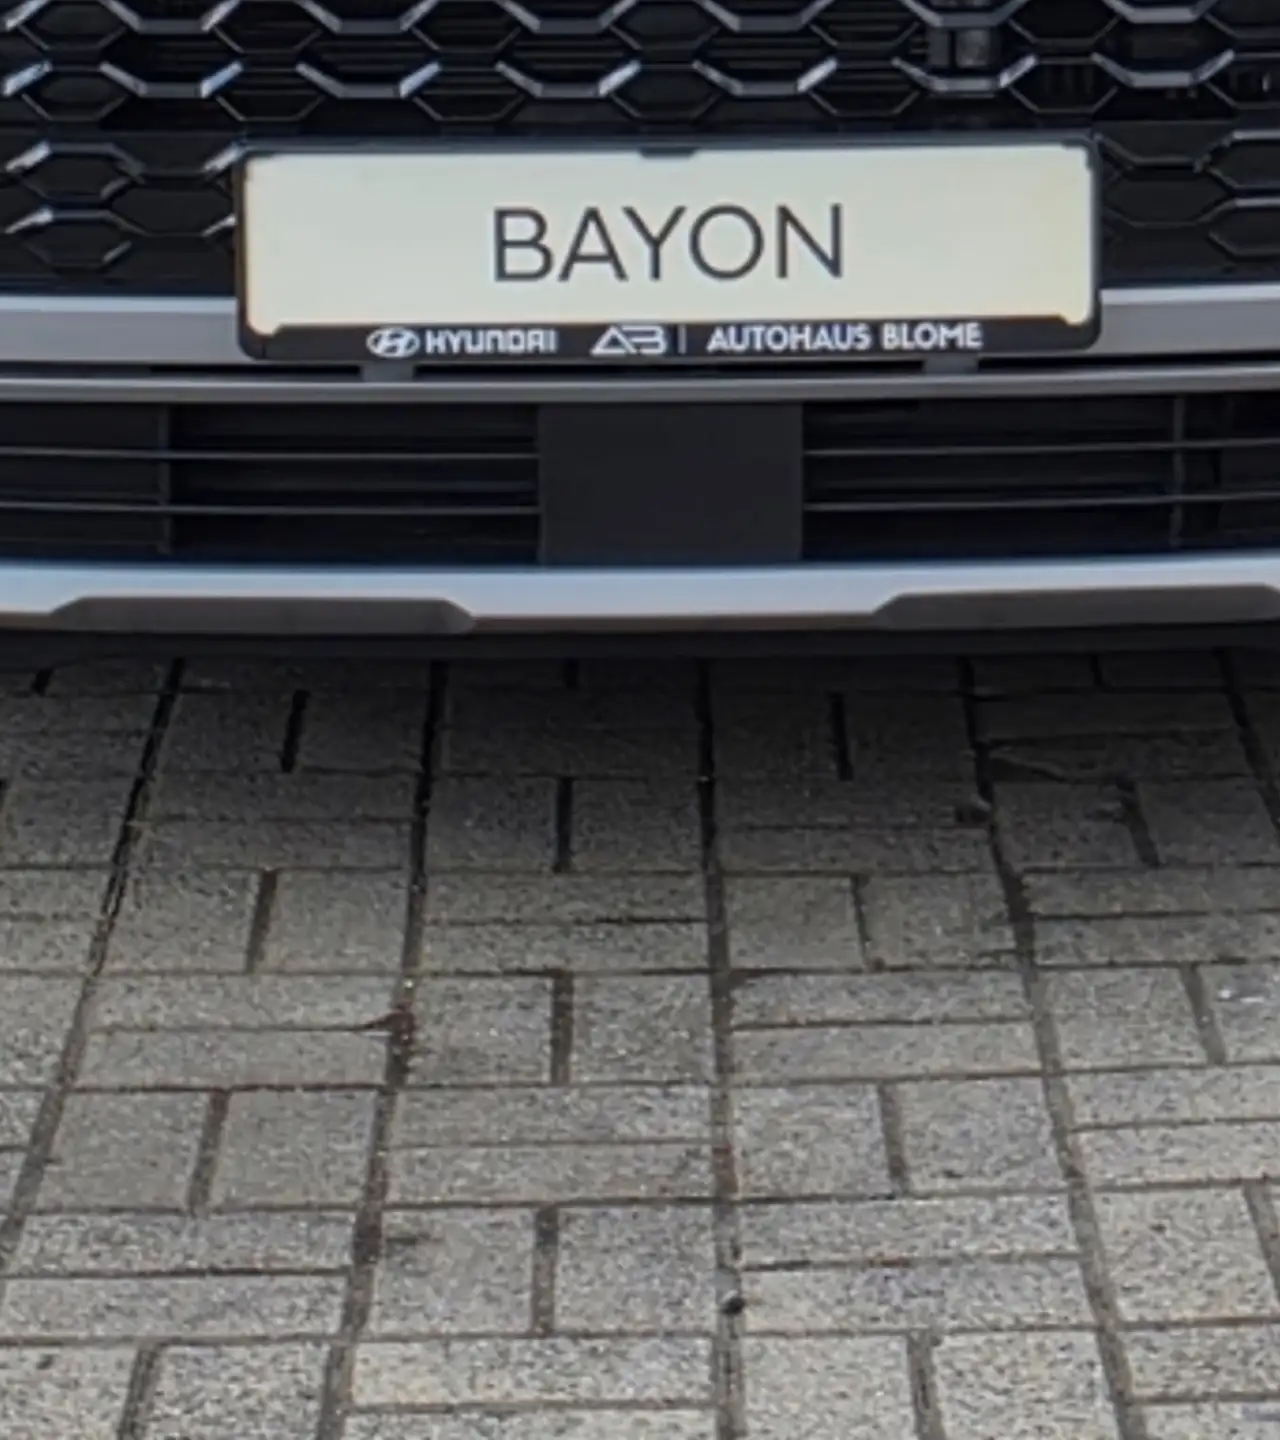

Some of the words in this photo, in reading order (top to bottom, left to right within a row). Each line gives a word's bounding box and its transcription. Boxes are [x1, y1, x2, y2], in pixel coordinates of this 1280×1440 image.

[494, 202, 844, 282] BAYON
[425, 328, 557, 354] HYUNDAI
[707, 323, 871, 352] AUTOHAUS
[881, 321, 983, 350] BLOME
